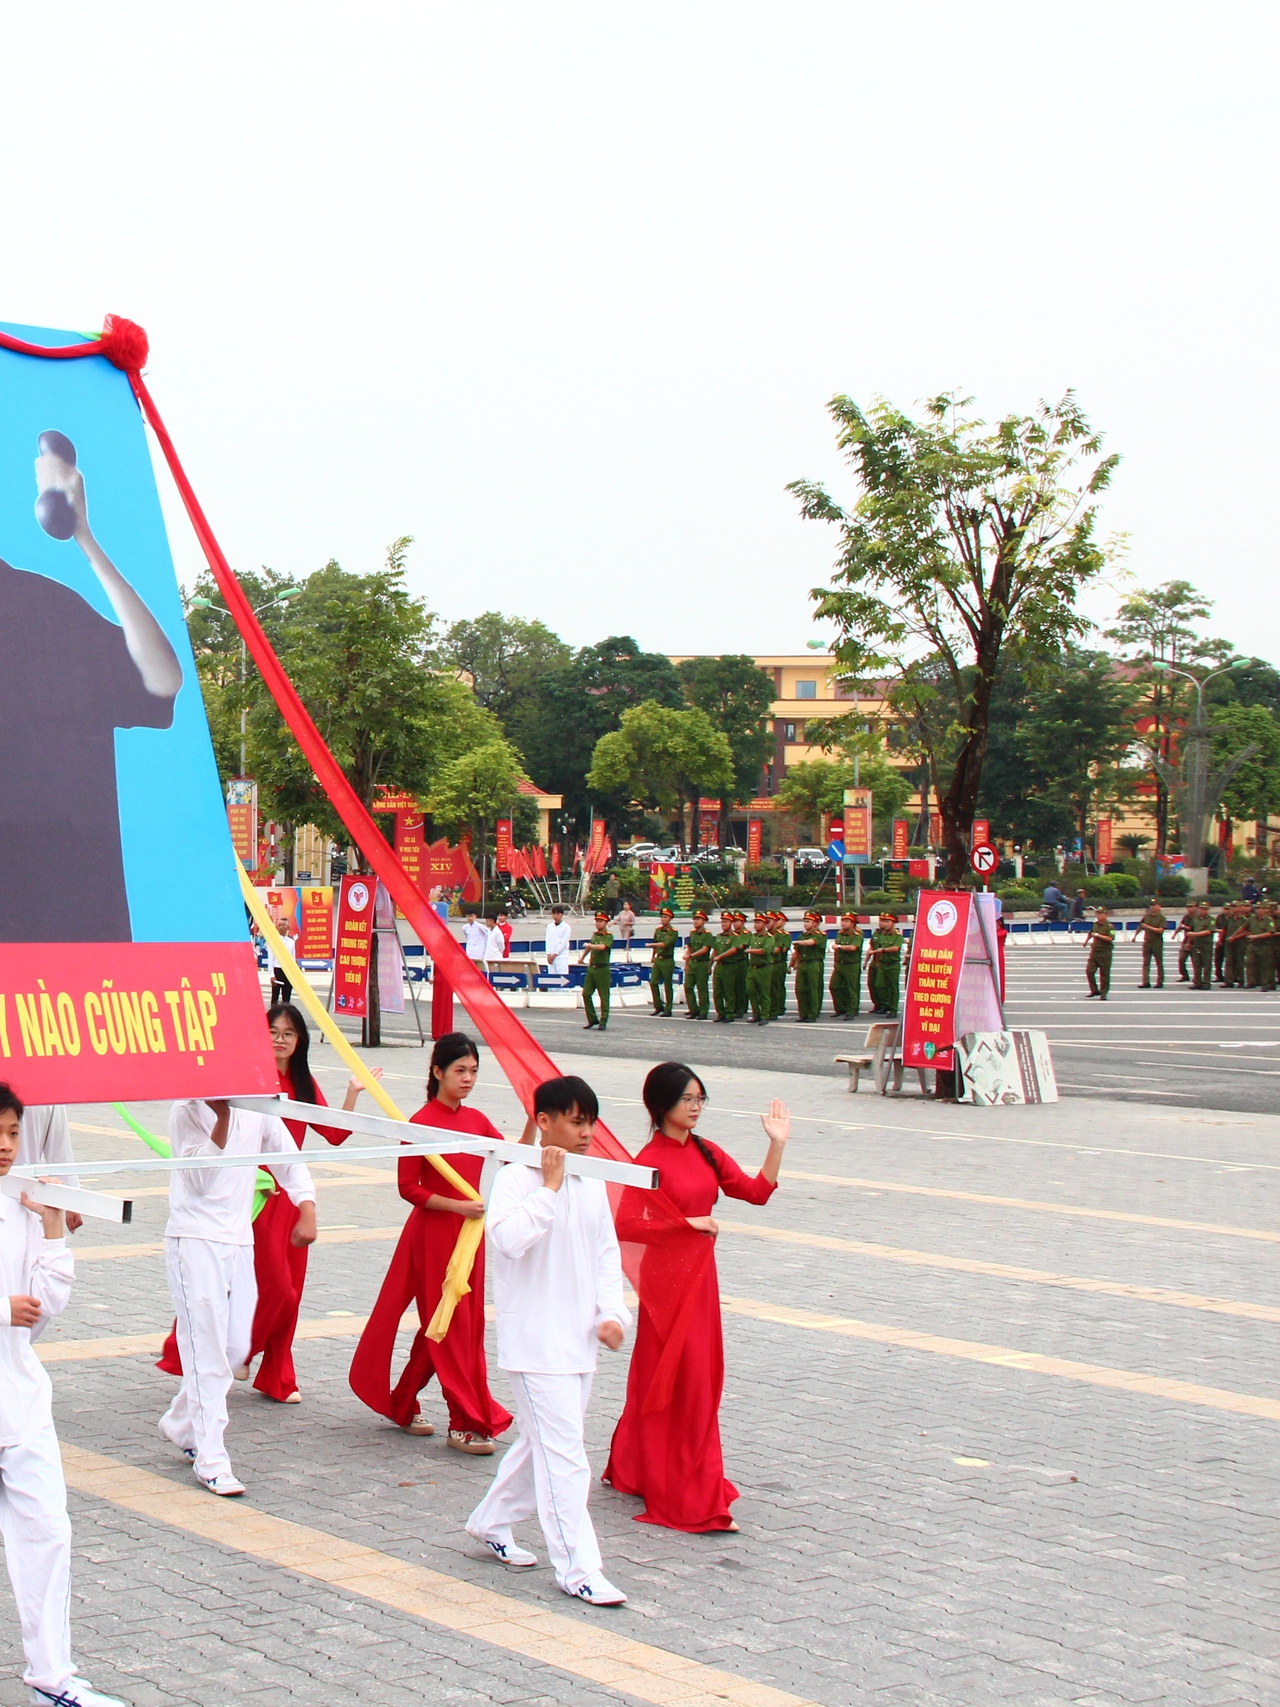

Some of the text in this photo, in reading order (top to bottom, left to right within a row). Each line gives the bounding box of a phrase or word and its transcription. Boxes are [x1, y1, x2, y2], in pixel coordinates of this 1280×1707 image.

[430, 863, 452, 871] XIV
[339, 954, 350, 965] CAO
[931, 963, 953, 976] LUYỆN
[918, 976, 936, 988] THÂN
[913, 991, 929, 1002] THEO
[919, 1005, 933, 1017] BÁC
[15, 978, 81, 1057] NÀO
[84, 979, 167, 1056] CŨNG
[166, 972, 227, 1066] TẬP”
